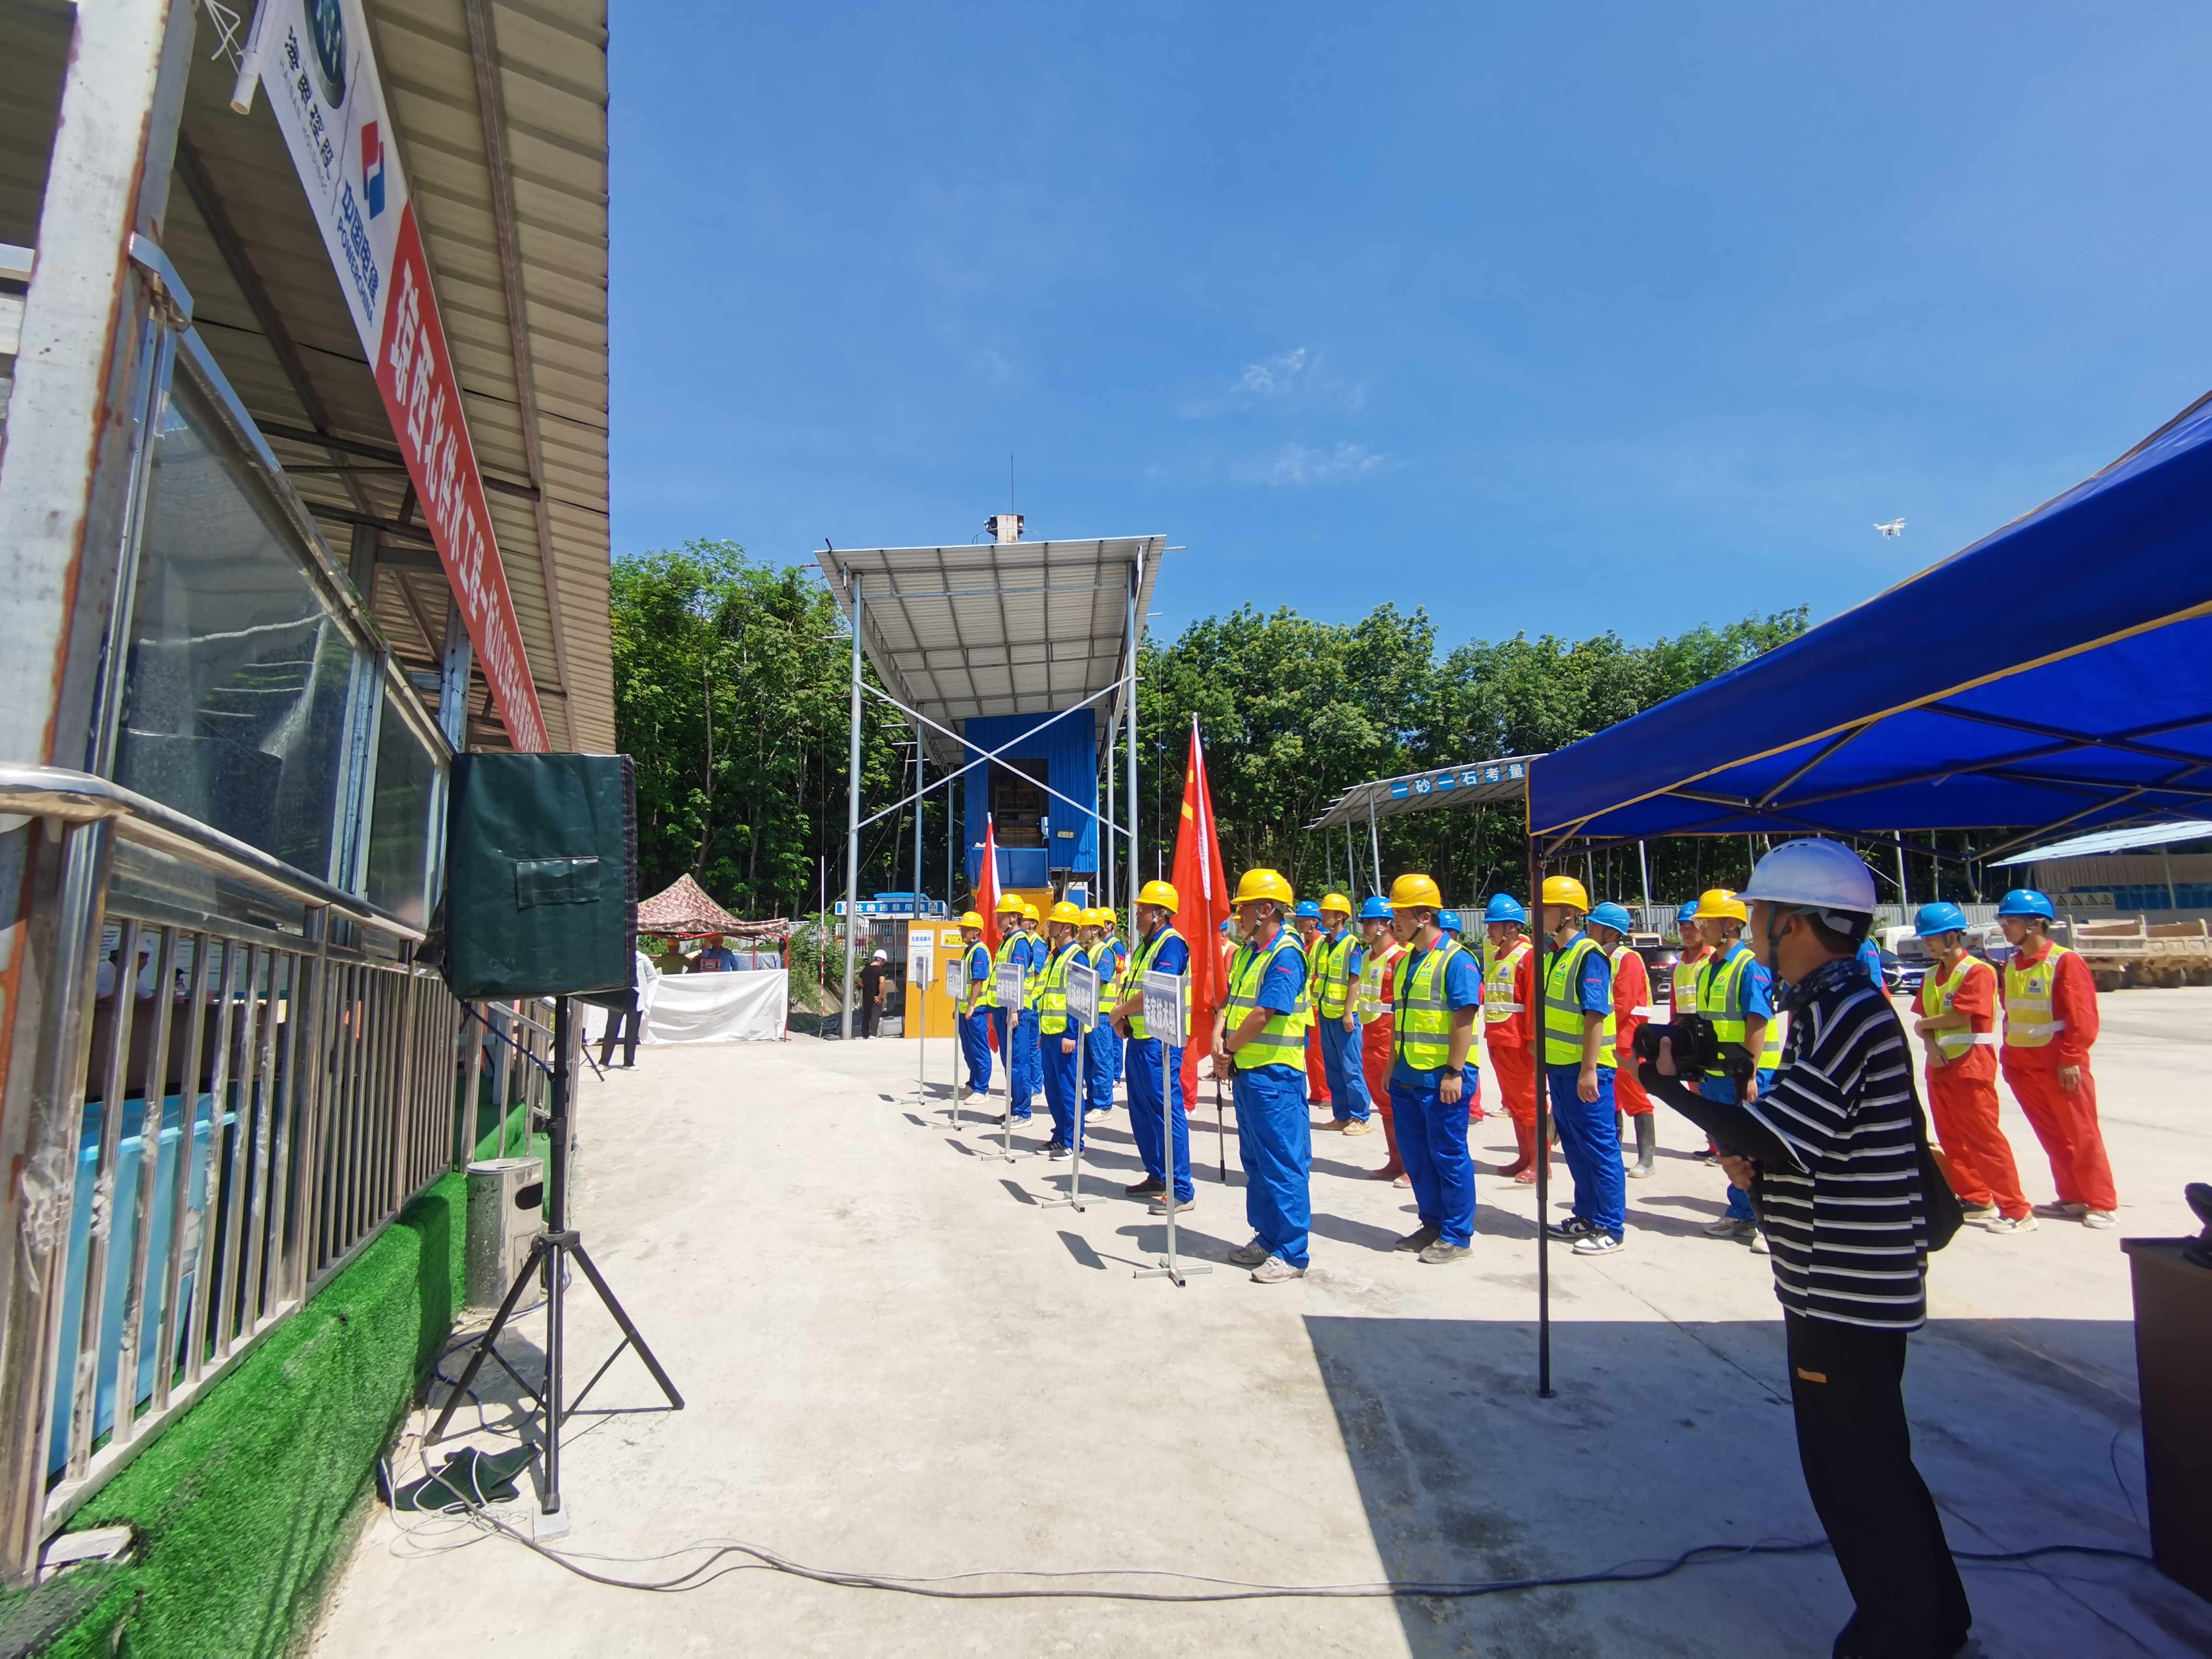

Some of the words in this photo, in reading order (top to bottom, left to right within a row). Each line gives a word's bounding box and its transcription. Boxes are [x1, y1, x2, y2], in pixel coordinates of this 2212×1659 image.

[285, 25, 334, 180] 海南控股
[337, 217, 373, 327] POWERCHINA
[341, 180, 380, 306] 中国电建
[1392, 763, 1525, 795] 一砂一石考量
[1144, 994, 1176, 1036] 专家技术组
